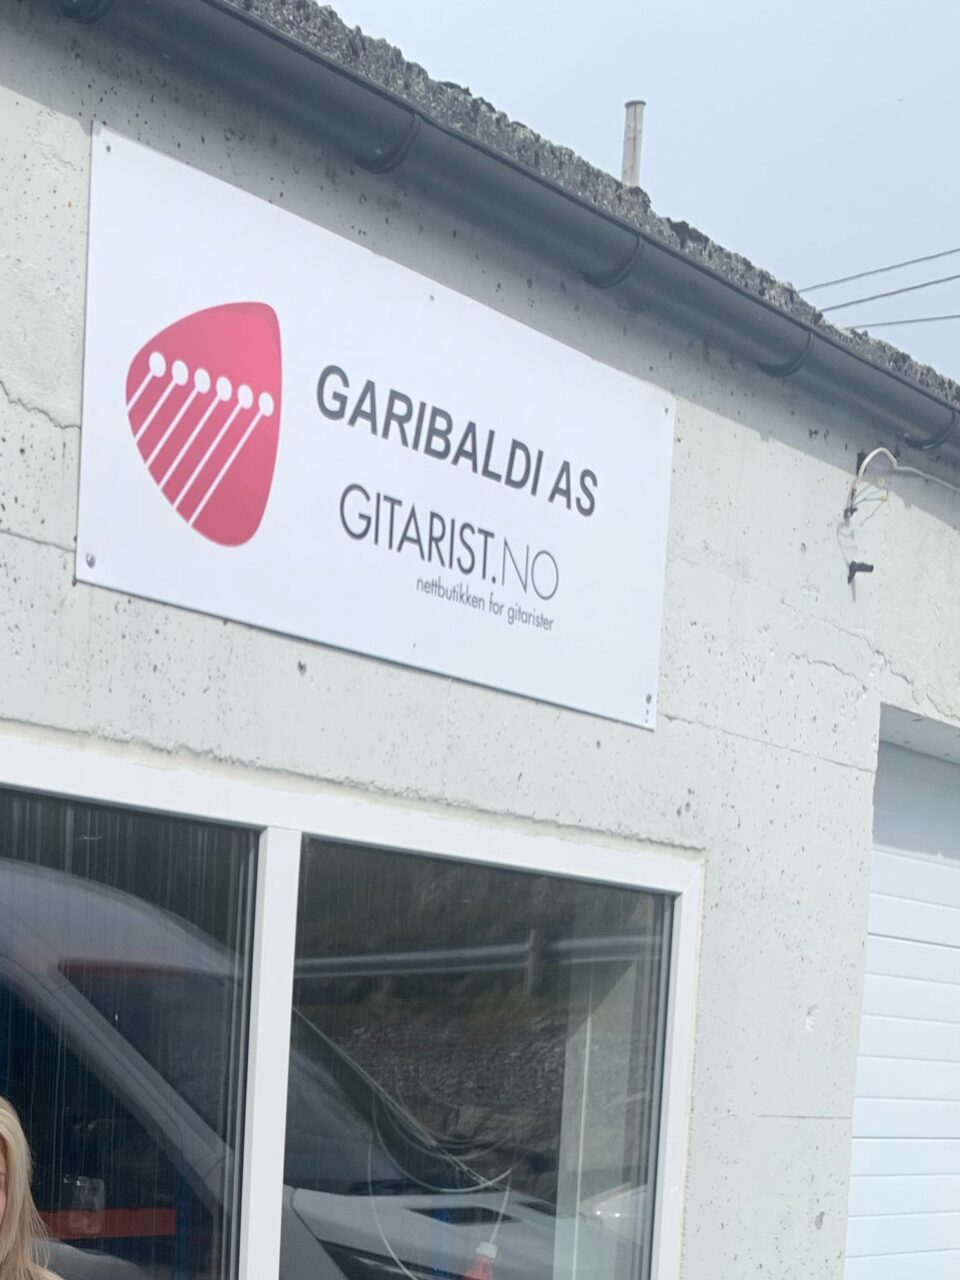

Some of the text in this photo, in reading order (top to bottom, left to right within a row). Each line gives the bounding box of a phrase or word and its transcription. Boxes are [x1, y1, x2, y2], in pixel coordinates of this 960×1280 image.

[316, 364, 598, 518] GARIBALDI AS
[339, 483, 559, 601] GITARIST.NO
[416, 575, 554, 631] nettbutikken for gitarister
